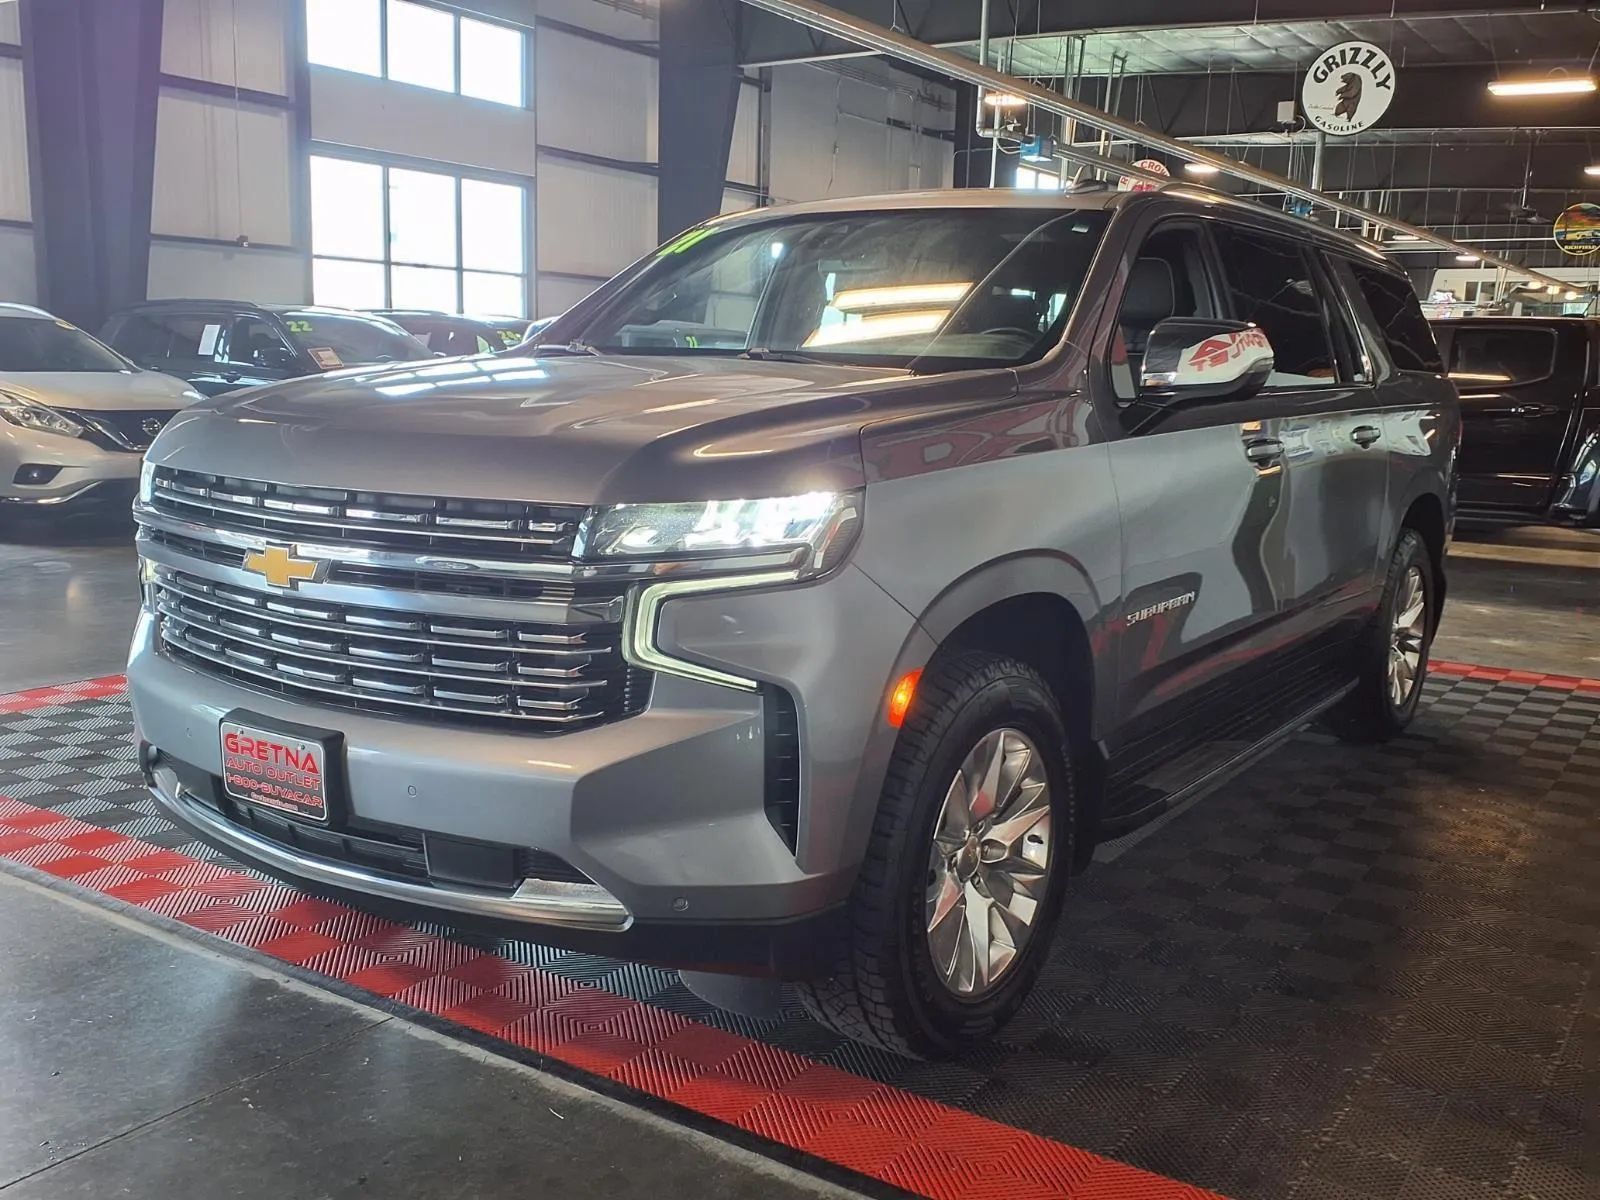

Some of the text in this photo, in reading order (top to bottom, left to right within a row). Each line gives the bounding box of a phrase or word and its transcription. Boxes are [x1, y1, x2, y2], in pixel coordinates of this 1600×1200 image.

[1313, 46, 1391, 90] GRIZZLY
[1314, 115, 1365, 132] GASOLINE
[286, 320, 313, 333] 22
[1126, 591, 1195, 627] SUBURBAN
[225, 733, 319, 774] GRETNA
[226, 757, 321, 791] AUTO OUTLET
[226, 772, 324, 808] 1-800-BUYACAR
